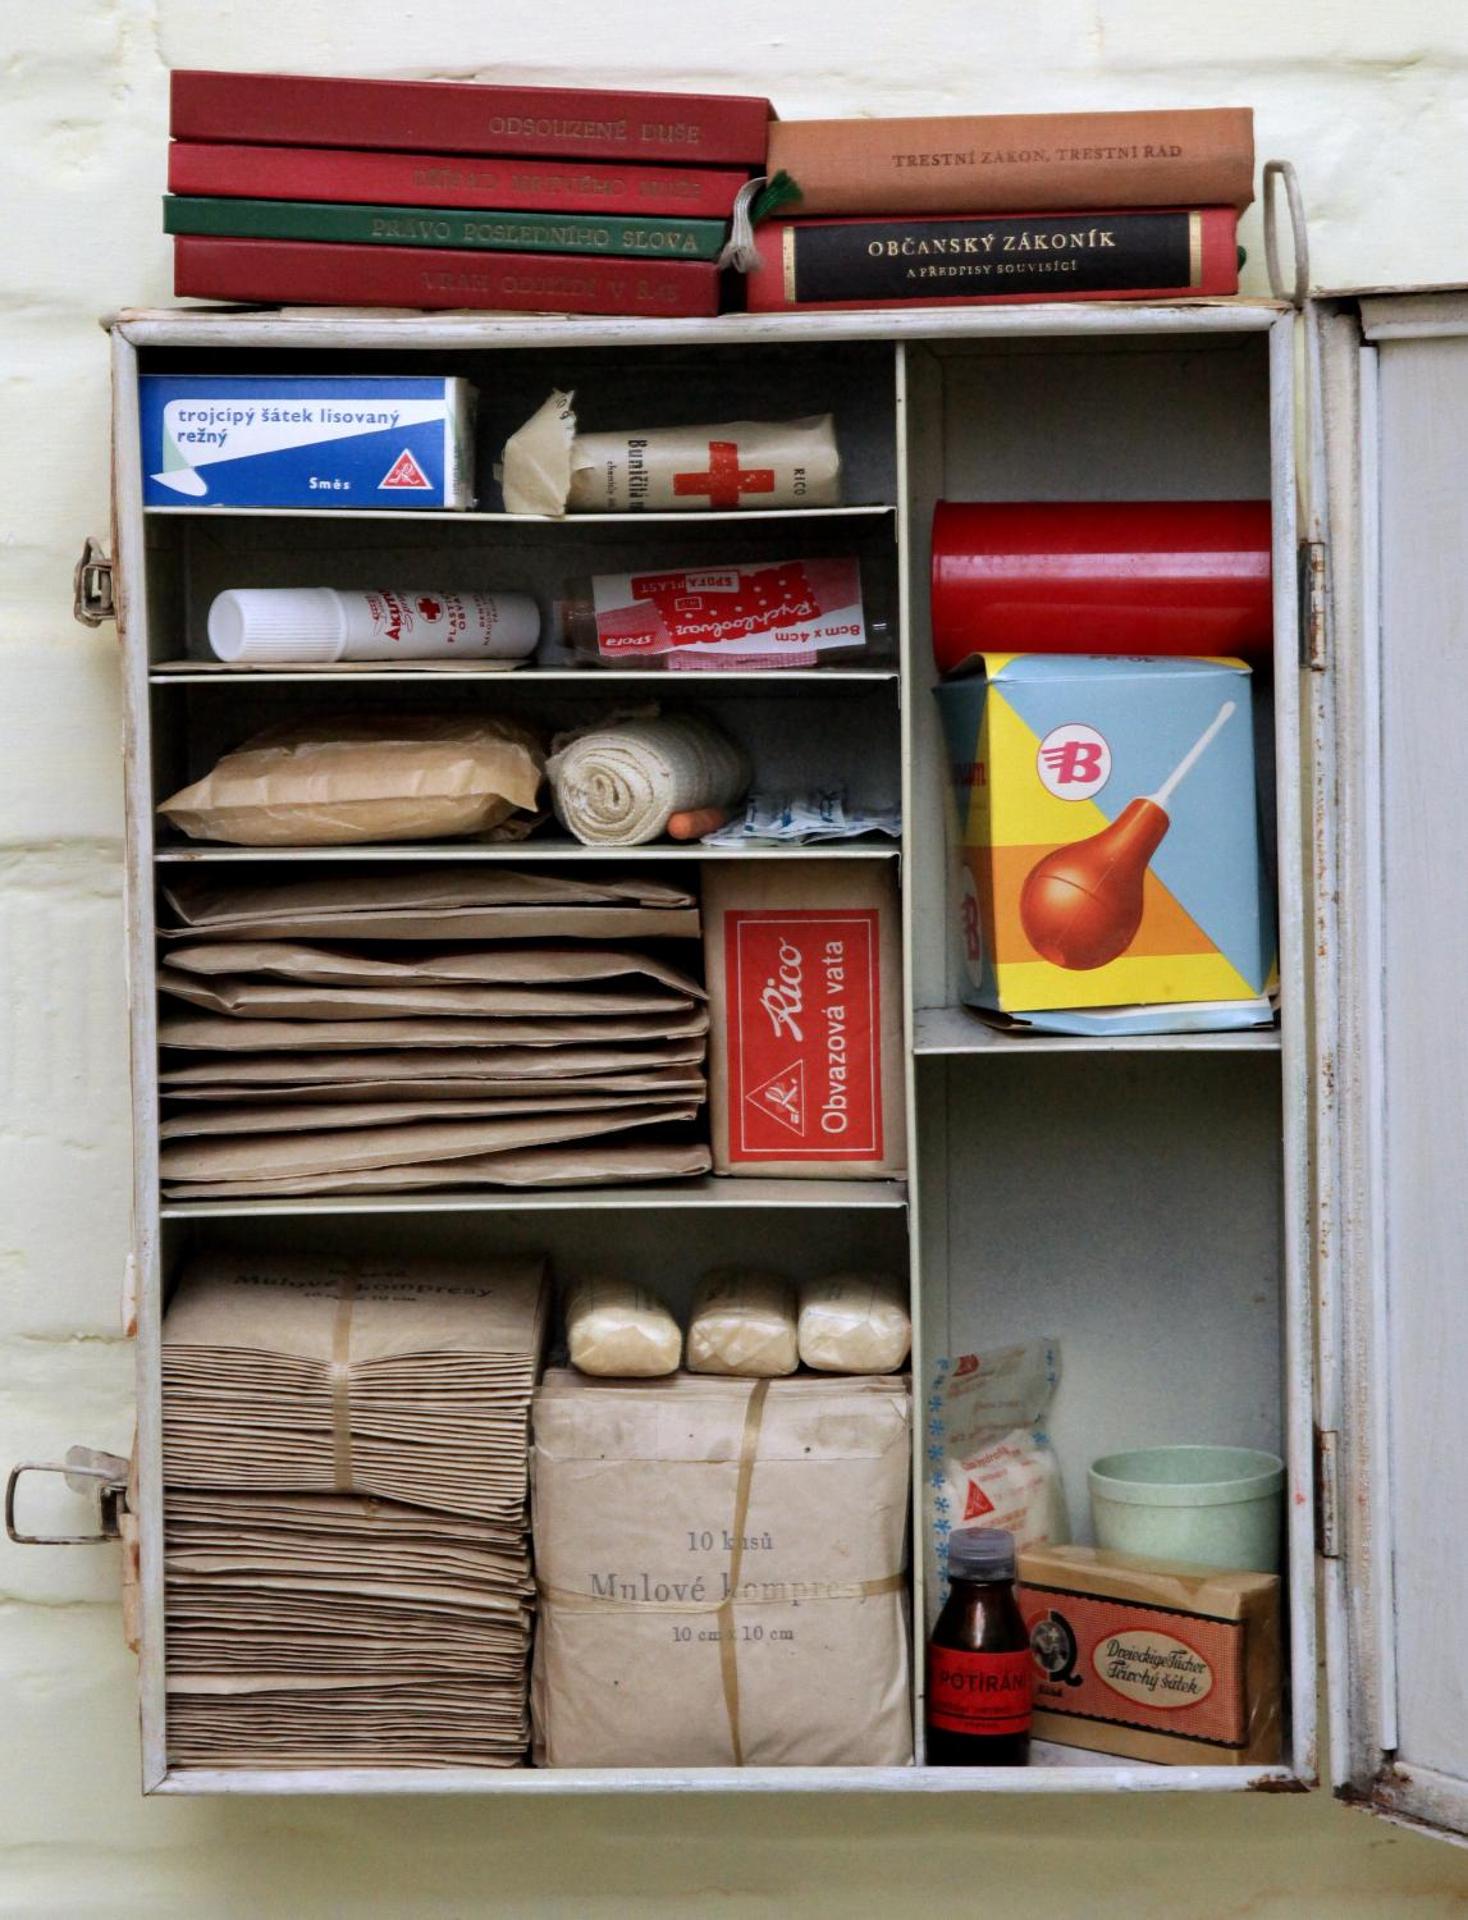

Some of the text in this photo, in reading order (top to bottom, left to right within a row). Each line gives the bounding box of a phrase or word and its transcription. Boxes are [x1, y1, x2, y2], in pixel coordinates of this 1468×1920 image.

[487, 117, 700, 144] ODSOUZENÉ DUŠE
[891, 150, 976, 168] TRESTNÍ
[370, 218, 699, 252] PRÁVO POSLEDNÍHO SLOVA
[867, 229, 1117, 257] OBČANSKÝ ZÁKONÍK
[906, 268, 917, 279] A
[919, 262, 997, 279] PŘEDPISY
[178, 405, 401, 428] trojcípý šátek lisovaný
[177, 427, 229, 448] režný
[308, 477, 351, 490] Směs
[793, 467, 807, 497] RICO
[774, 630, 811, 644] 4cm
[825, 623, 861, 638] 8cm
[822, 940, 844, 995] vata
[760, 936, 804, 1043] Rico
[821, 1004, 849, 1134] Obvazová
[686, 1531, 713, 1551] 10
[588, 1572, 705, 1602] Mulové
[672, 1626, 692, 1642] 10
[697, 1629, 721, 1642] cm
[742, 1625, 764, 1642] 10
[769, 1629, 795, 1642] cm
